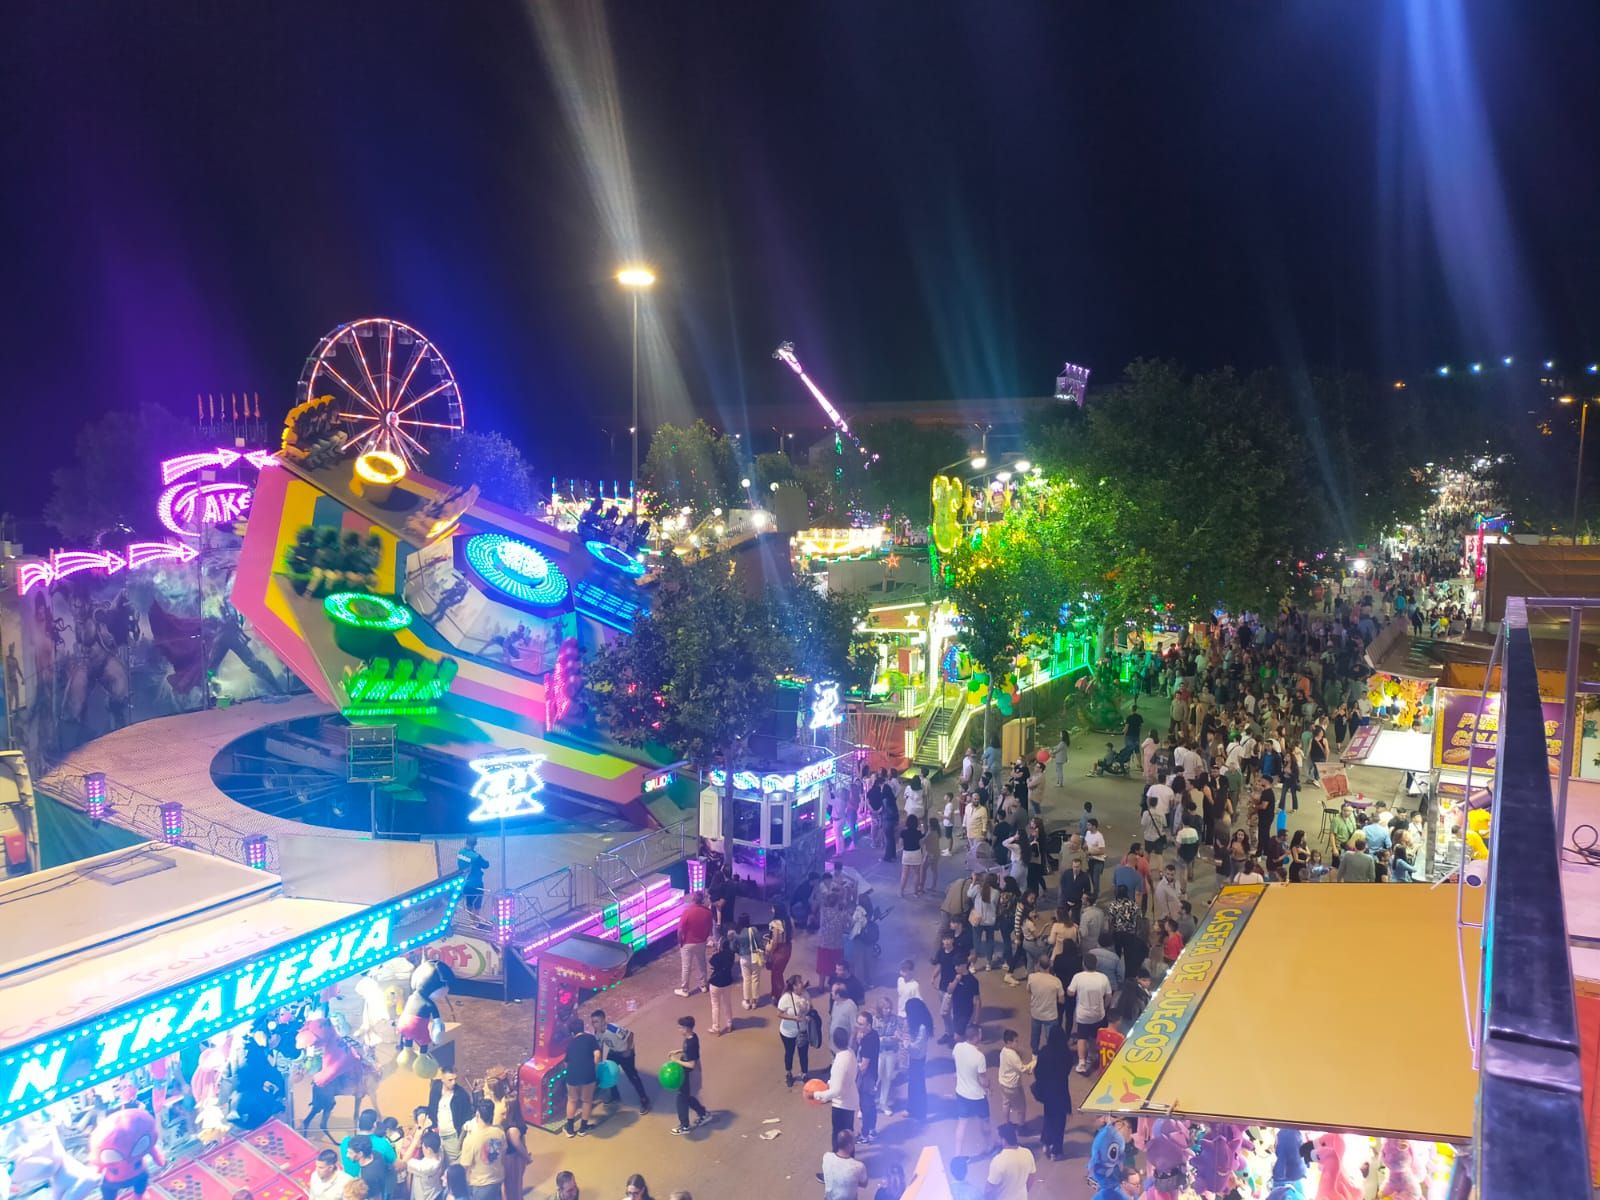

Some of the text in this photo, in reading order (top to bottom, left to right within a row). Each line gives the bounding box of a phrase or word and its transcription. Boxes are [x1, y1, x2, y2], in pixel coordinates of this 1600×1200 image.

[174, 483, 252, 523] TAKE
[95, 916, 391, 1070] TRAVESIA
[1125, 907, 1243, 1063] CASETA DE JUEGOS
